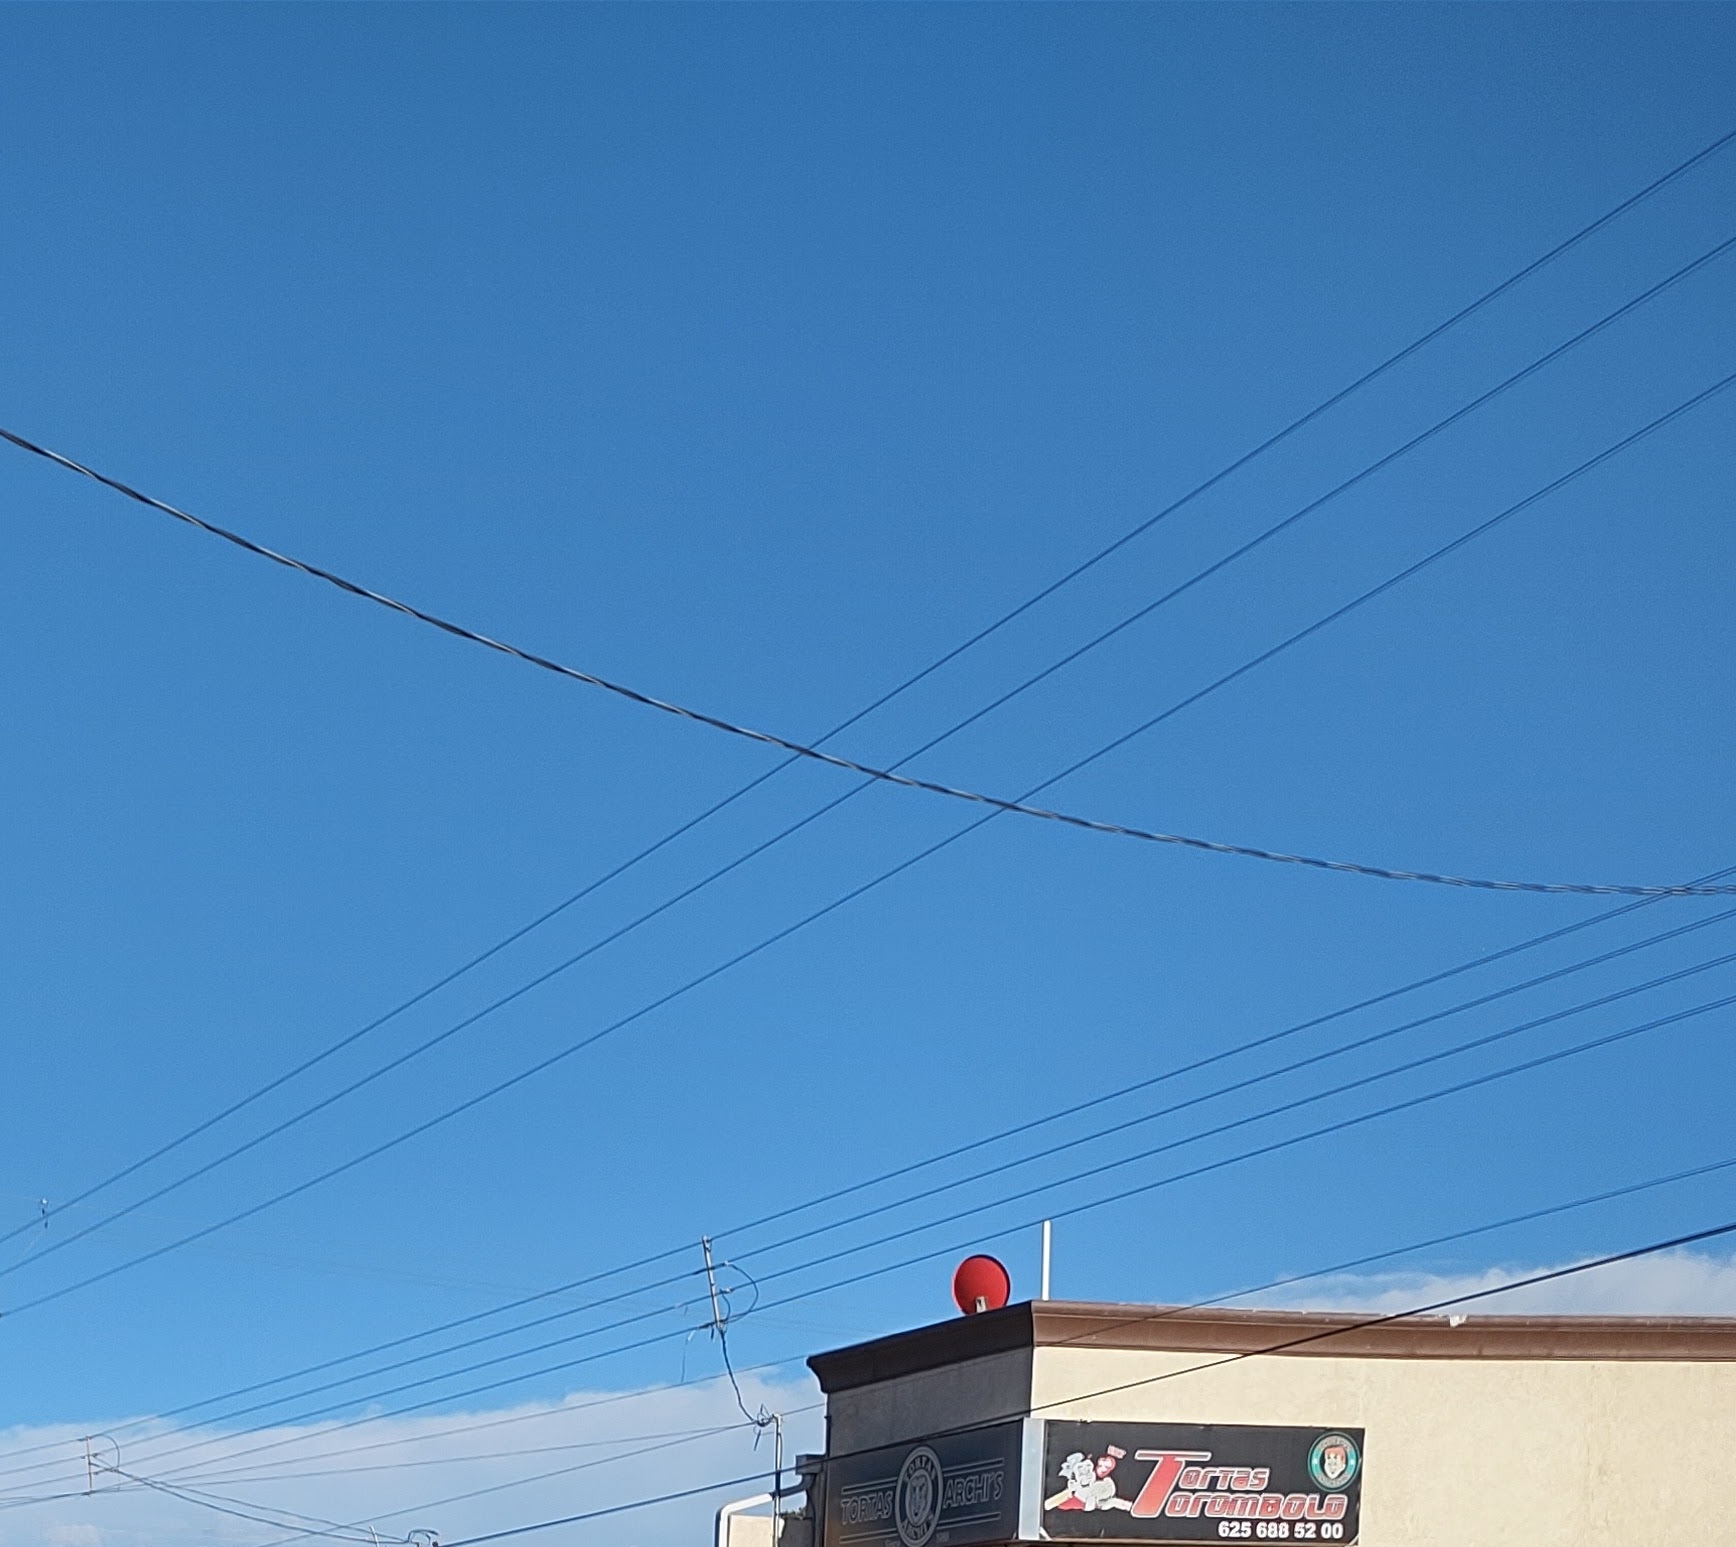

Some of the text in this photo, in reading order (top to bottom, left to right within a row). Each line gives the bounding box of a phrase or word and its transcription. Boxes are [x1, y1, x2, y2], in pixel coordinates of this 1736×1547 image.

[841, 1491, 893, 1526] TORTAS
[1218, 1521, 1344, 1539] 625 688 52 00
